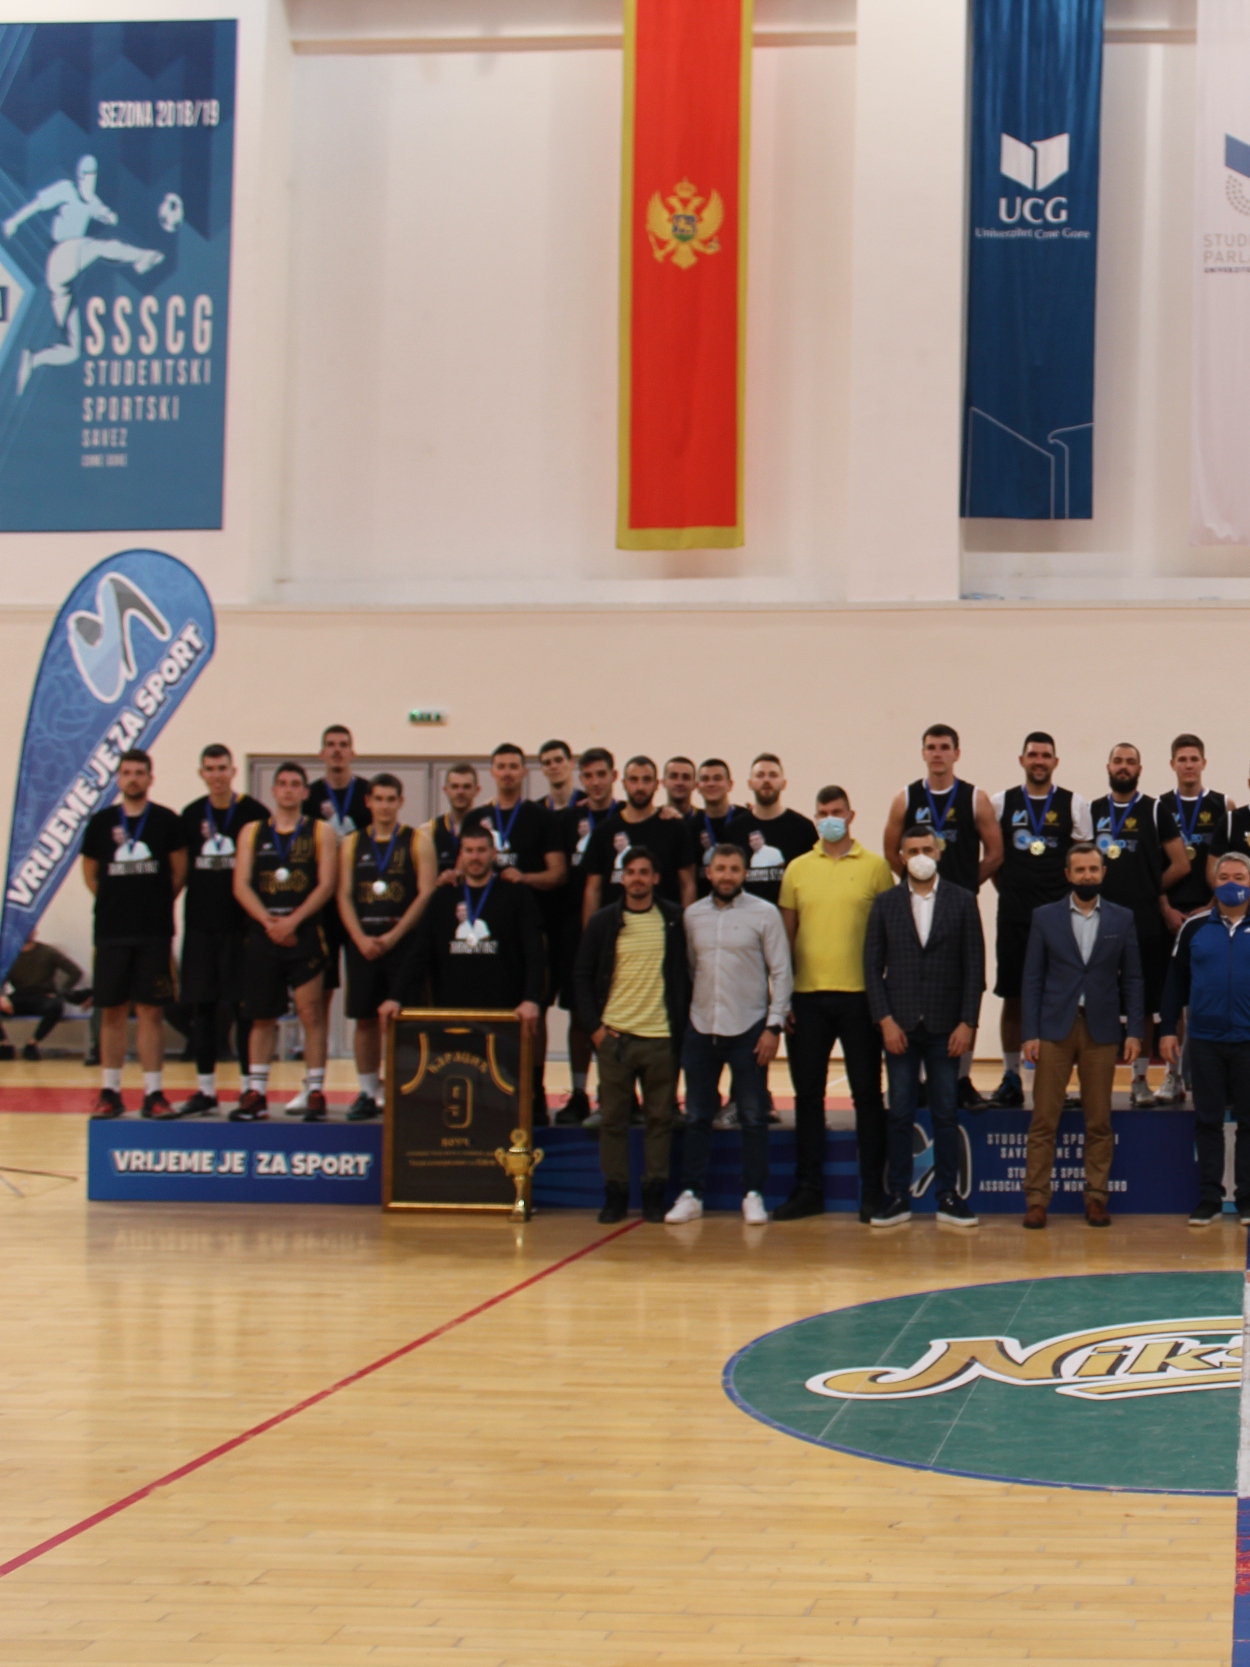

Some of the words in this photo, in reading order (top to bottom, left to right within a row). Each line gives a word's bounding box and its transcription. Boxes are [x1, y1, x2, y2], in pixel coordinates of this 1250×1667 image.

[99, 101, 154, 128] SEZONA
[999, 197, 1068, 224] UCG
[85, 294, 213, 356] SSSCG
[84, 358, 211, 387] STUDENTSKI
[82, 395, 179, 422] SPORTSKI
[7, 777, 101, 905] VRIJEME
[88, 743, 124, 788] JE
[109, 710, 145, 753] ZA
[135, 622, 205, 717] SPORT
[113, 1150, 213, 1173] VRIJEME
[217, 1151, 245, 1173] JE
[256, 1154, 288, 1175] ZA
[291, 1154, 371, 1175] SPORT
